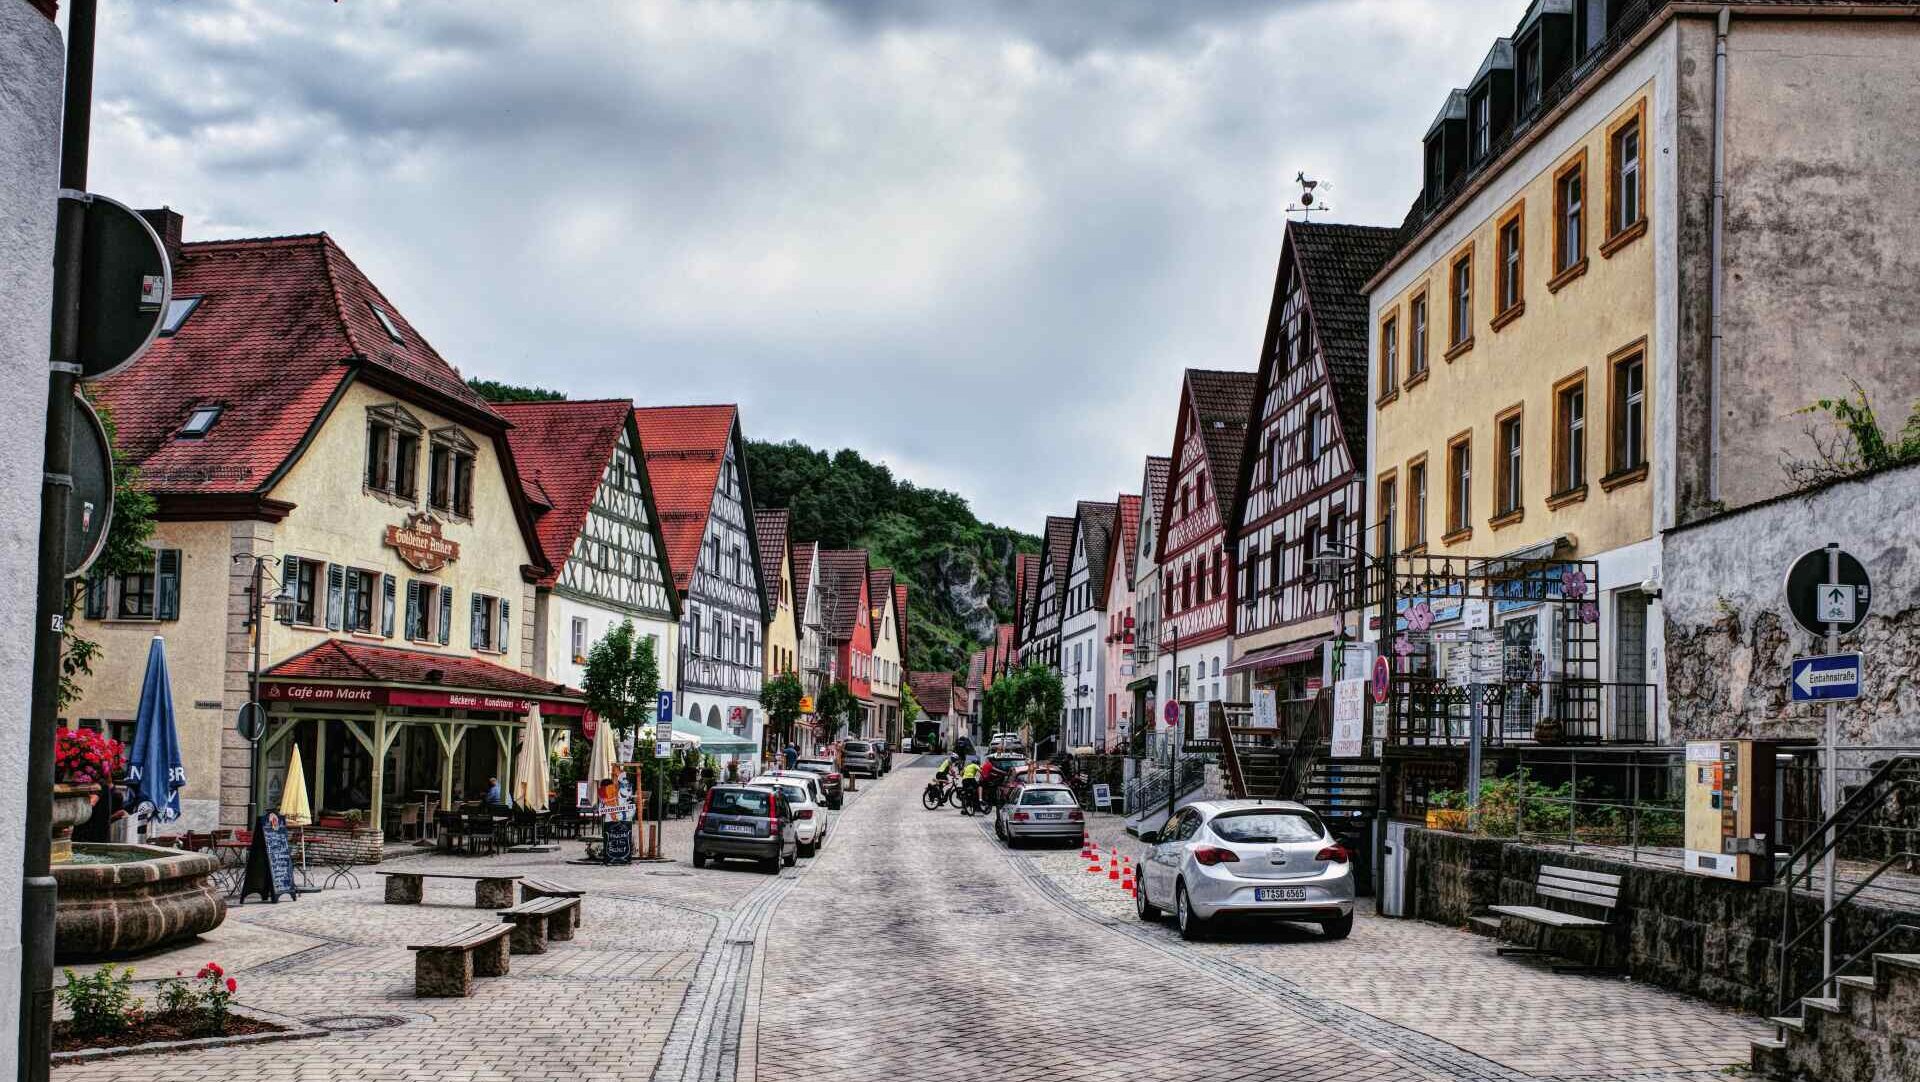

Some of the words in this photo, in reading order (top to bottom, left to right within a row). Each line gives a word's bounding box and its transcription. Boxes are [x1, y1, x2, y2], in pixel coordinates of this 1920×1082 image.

[1809, 671, 1855, 684] Einbahnstraße
[287, 686, 313, 699] Café
[315, 690, 334, 699] am
[336, 688, 372, 700] Markt
[661, 695, 670, 719] P
